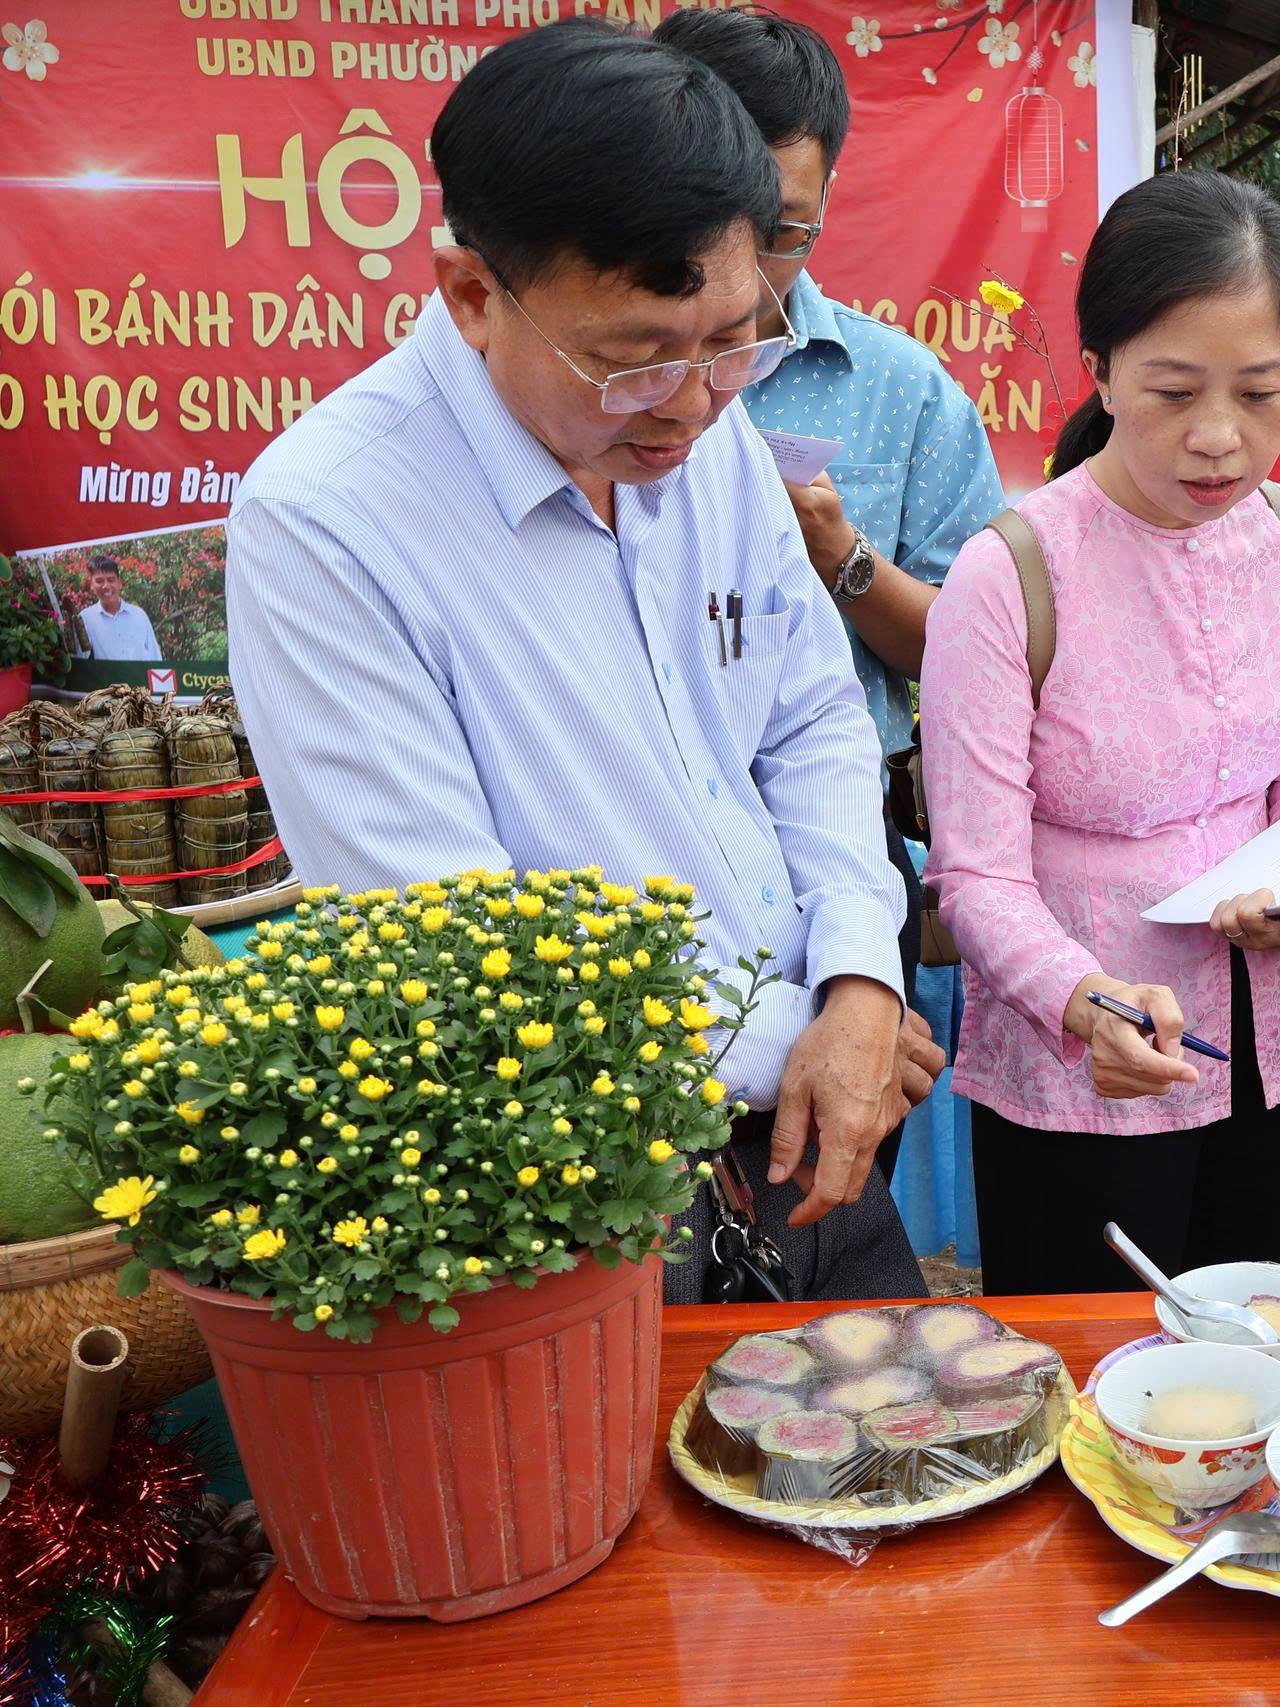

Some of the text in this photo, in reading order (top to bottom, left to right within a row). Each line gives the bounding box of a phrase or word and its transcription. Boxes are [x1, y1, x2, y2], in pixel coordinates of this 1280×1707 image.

[197, 37, 315, 77] UBND
[74, 273, 234, 348] BÁNH
[248, 273, 364, 350] DÂN
[43, 374, 159, 445] HỌC
[179, 375, 316, 432] SINH
[79, 461, 171, 507] Mừng
